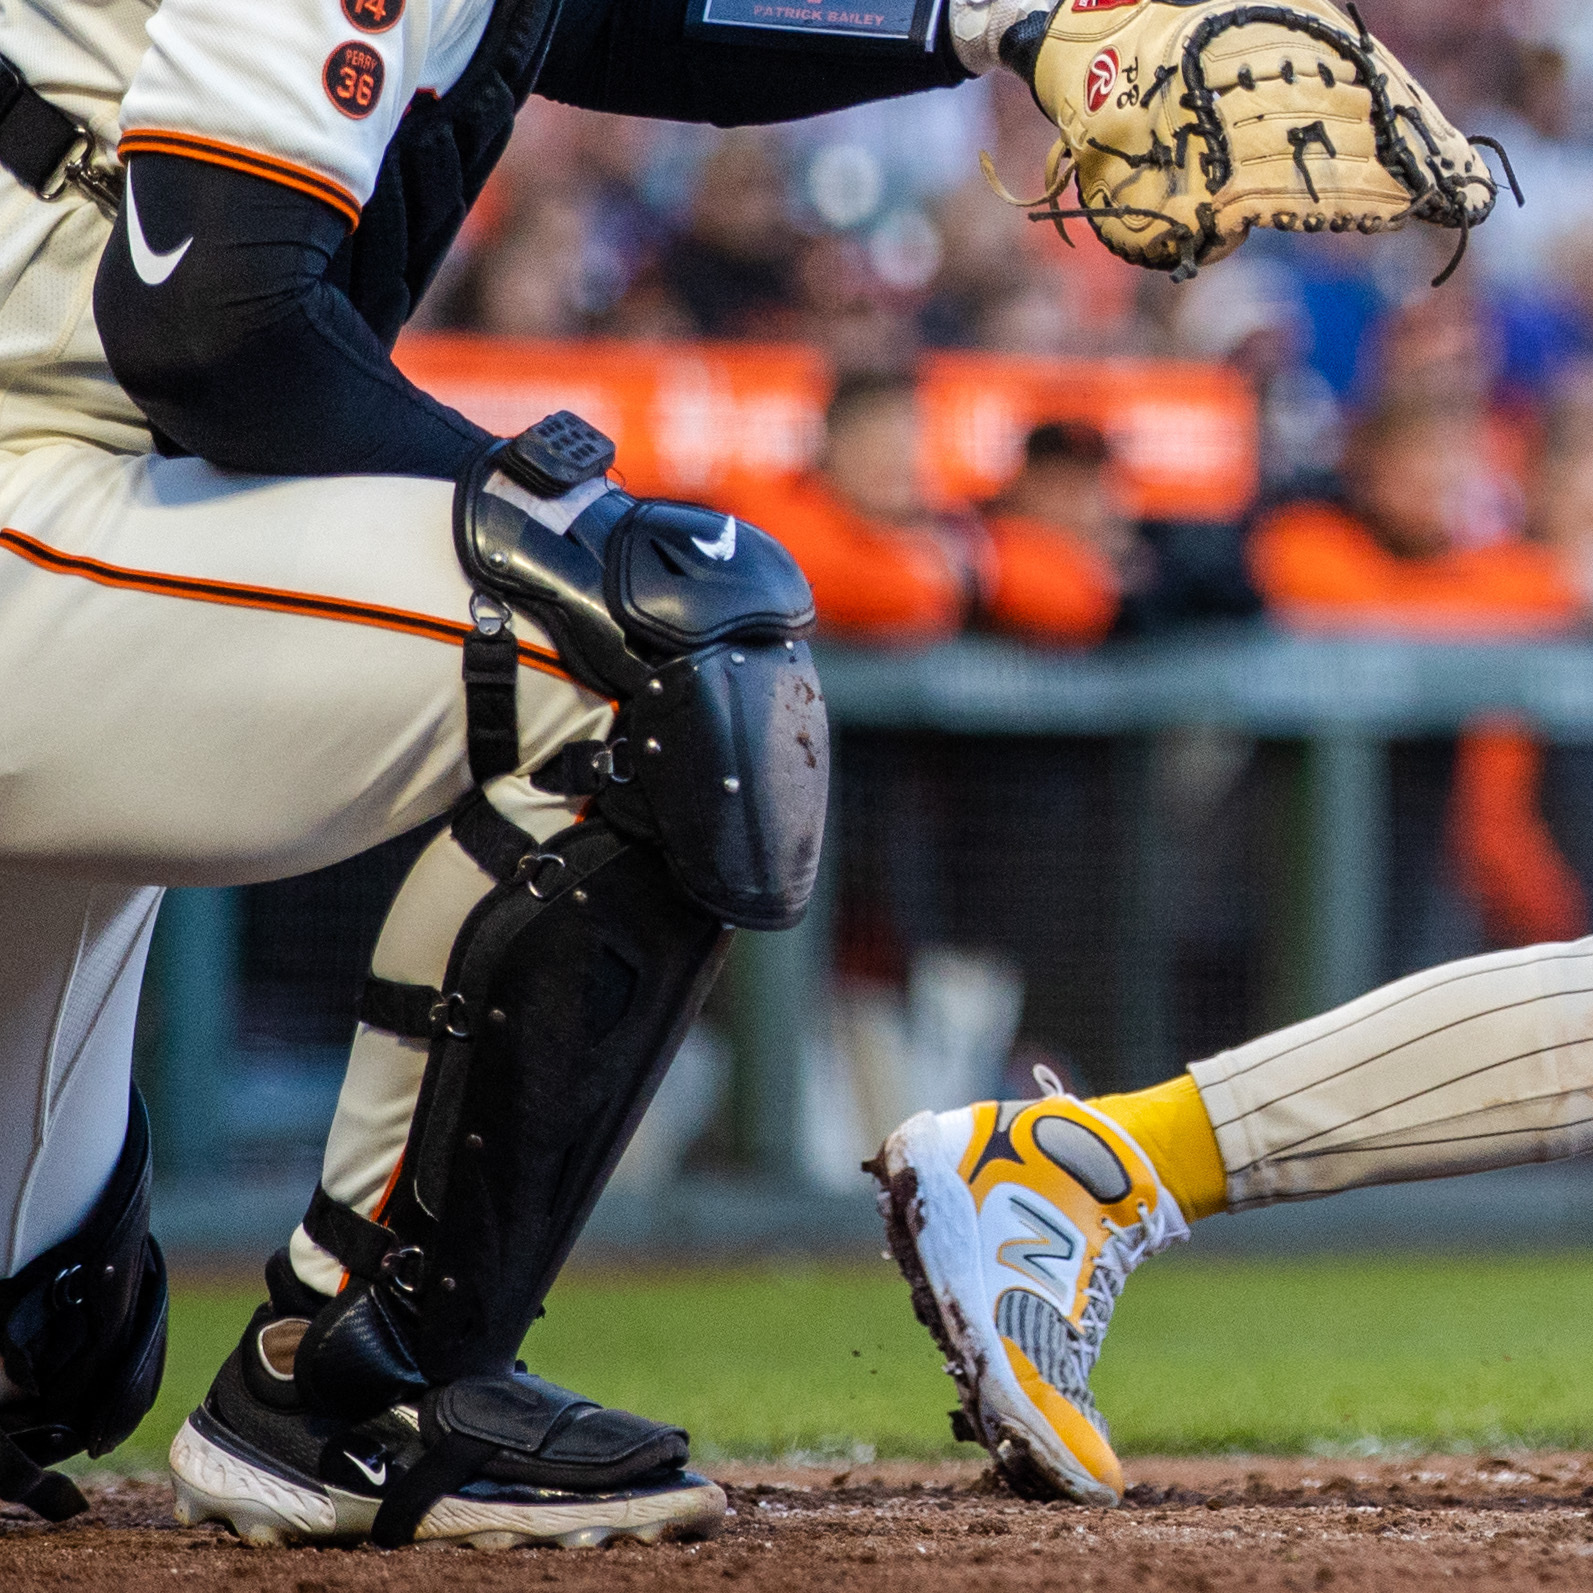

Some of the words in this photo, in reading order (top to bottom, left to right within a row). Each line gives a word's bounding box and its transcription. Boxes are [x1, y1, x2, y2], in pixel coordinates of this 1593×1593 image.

[753, 4, 822, 22] PATRICK
[828, 10, 885, 26] BAILEY
[345, 48, 378, 72] PERRY
[336, 66, 374, 106] 36
